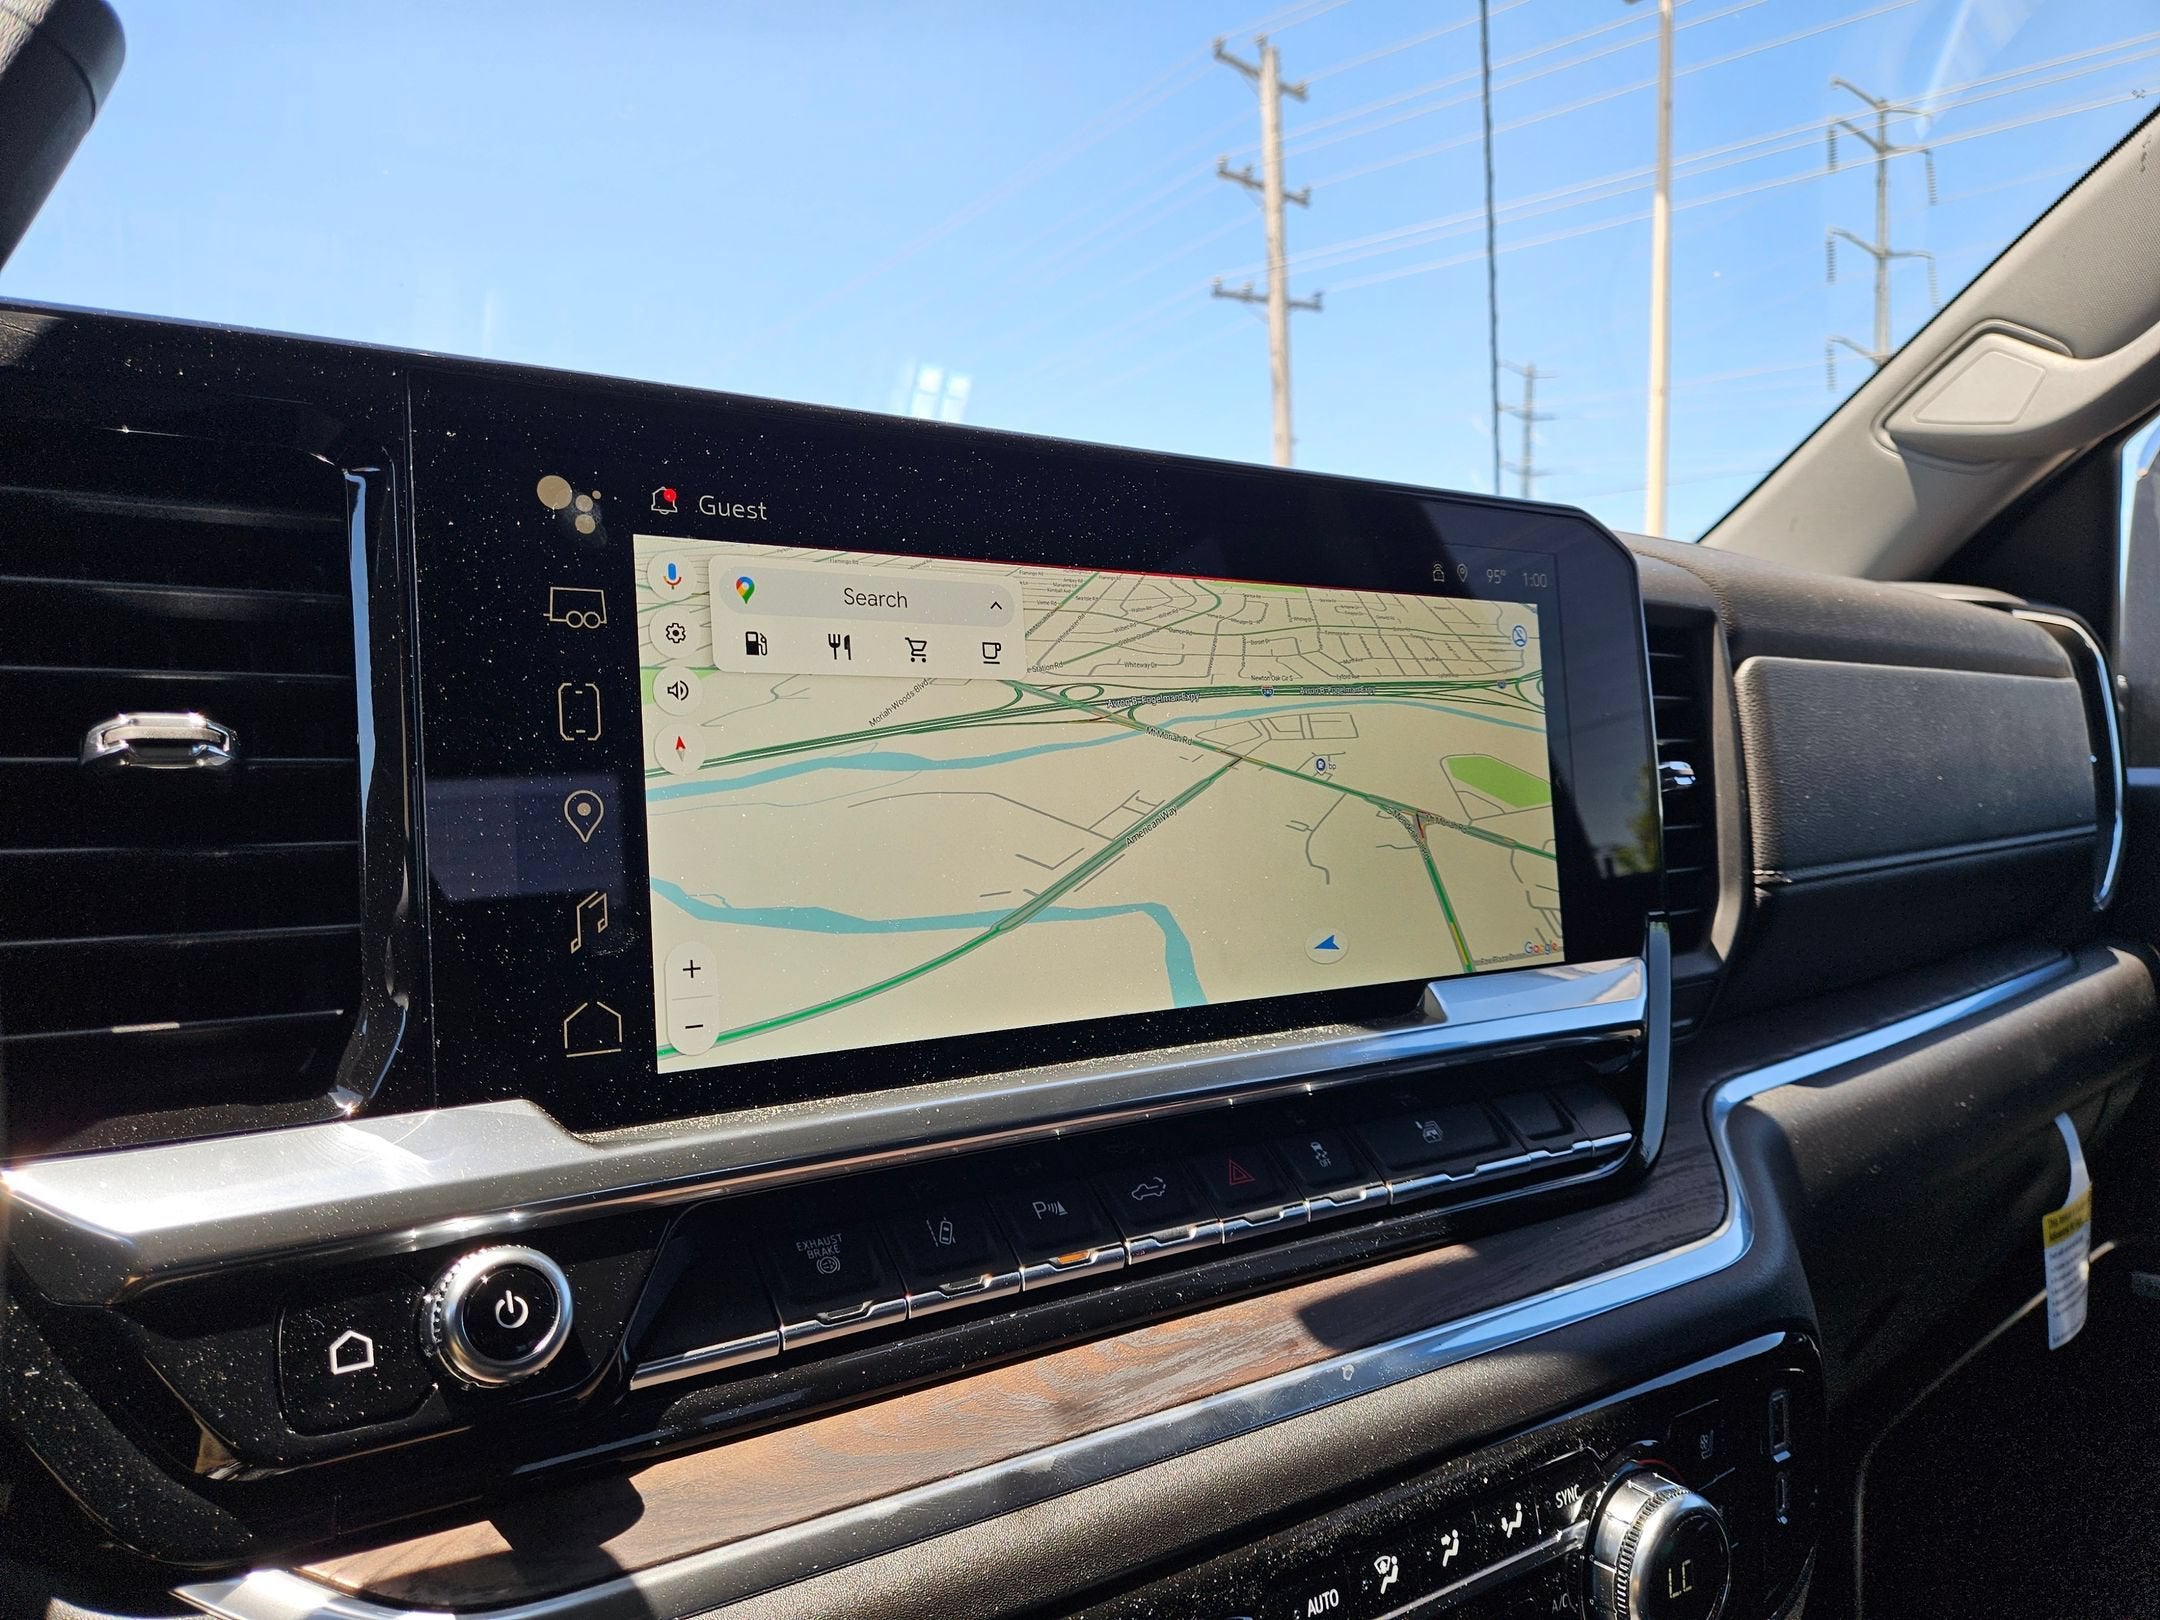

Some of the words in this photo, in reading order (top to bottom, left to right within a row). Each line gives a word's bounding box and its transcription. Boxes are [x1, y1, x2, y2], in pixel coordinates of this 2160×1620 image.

[699, 495, 769, 522] Guest
[1522, 572, 1548, 588] 1:00
[843, 587, 909, 611] Search
[1032, 664, 1054, 673] Station
[1053, 661, 1064, 670] Rd
[868, 707, 893, 727] Moriah
[891, 691, 915, 710] Woods
[914, 678, 929, 693] Blvd
[1141, 693, 1180, 706] Fogelman
[1180, 691, 1200, 703] Expy
[1182, 735, 1193, 746] Rd
[1125, 816, 1161, 847] American
[1159, 806, 1178, 824] Way
[795, 1232, 843, 1252] EXHAUST
[806, 1243, 841, 1260] BRAKE
[1555, 1483, 1581, 1510] SYNC
[1306, 1587, 1340, 1619] AUTO
[1551, 1591, 1570, 1615] A/C
